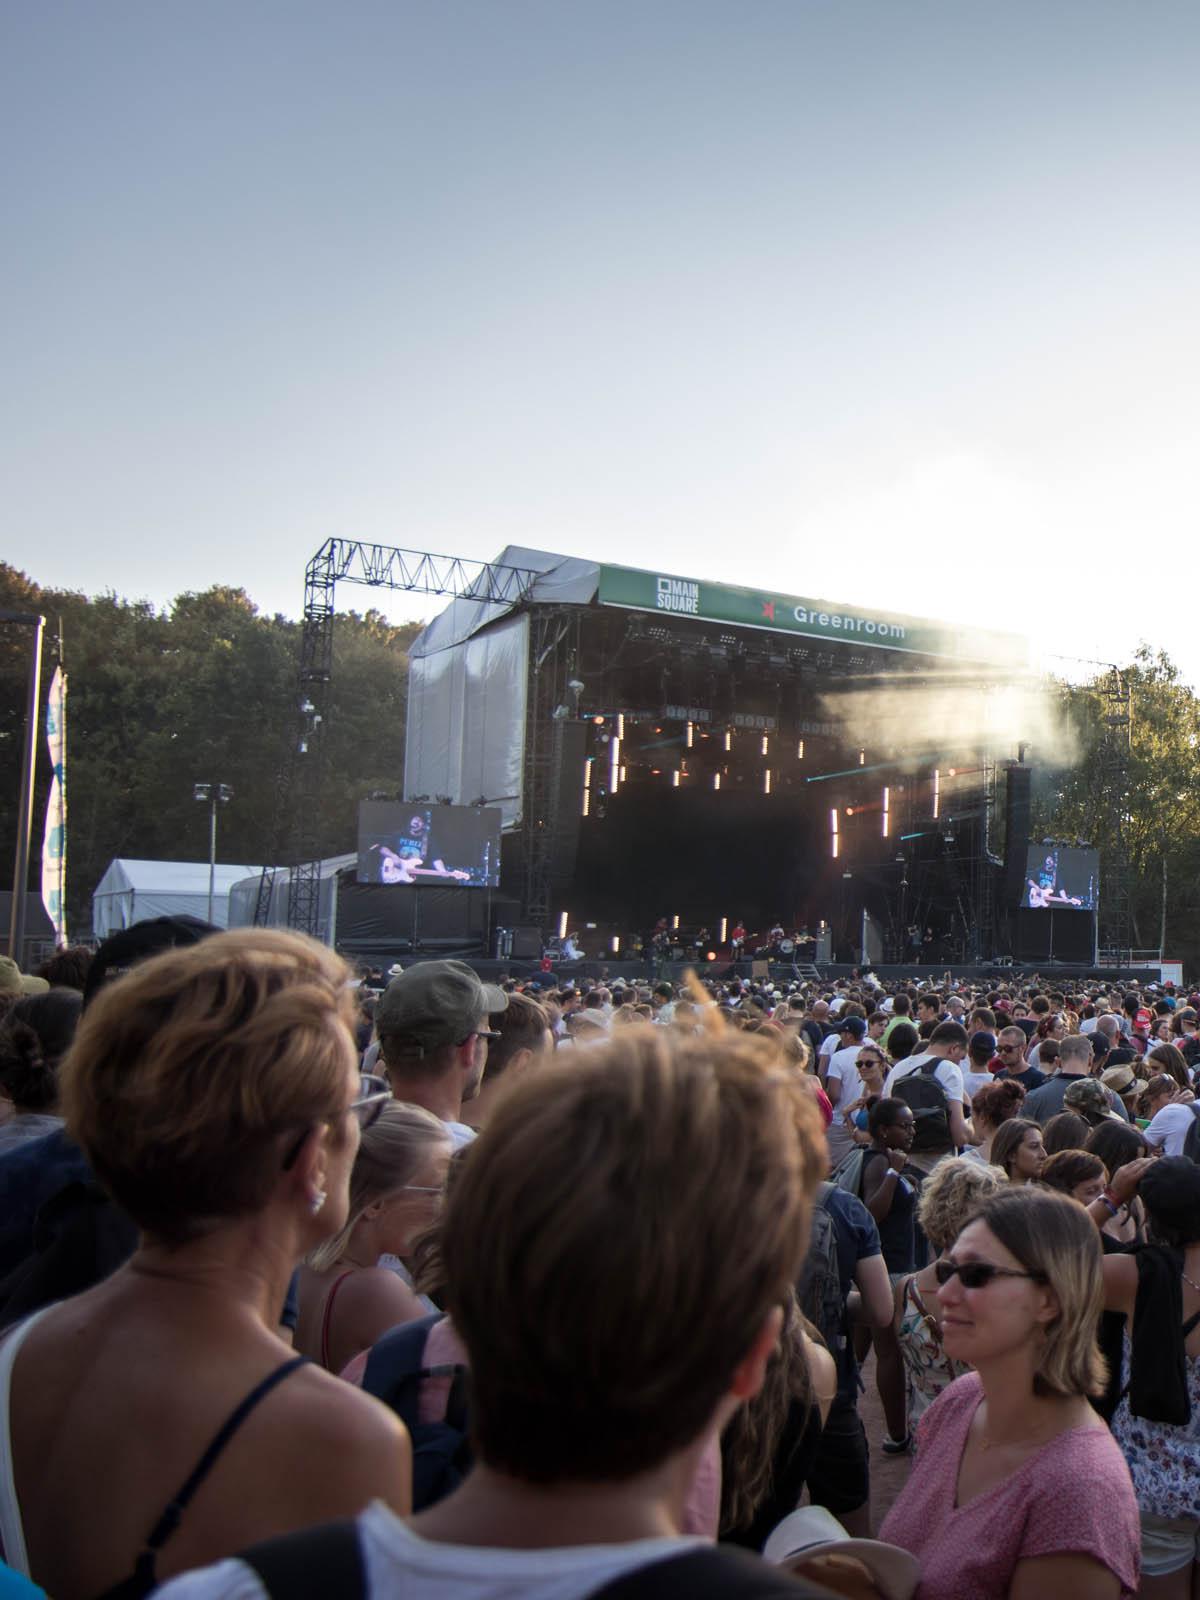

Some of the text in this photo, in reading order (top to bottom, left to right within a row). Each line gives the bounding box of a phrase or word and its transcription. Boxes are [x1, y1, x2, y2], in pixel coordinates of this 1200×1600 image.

[672, 580, 699, 599] MAIN
[657, 592, 699, 614] SQUARE
[794, 606, 905, 638] Greenroom
